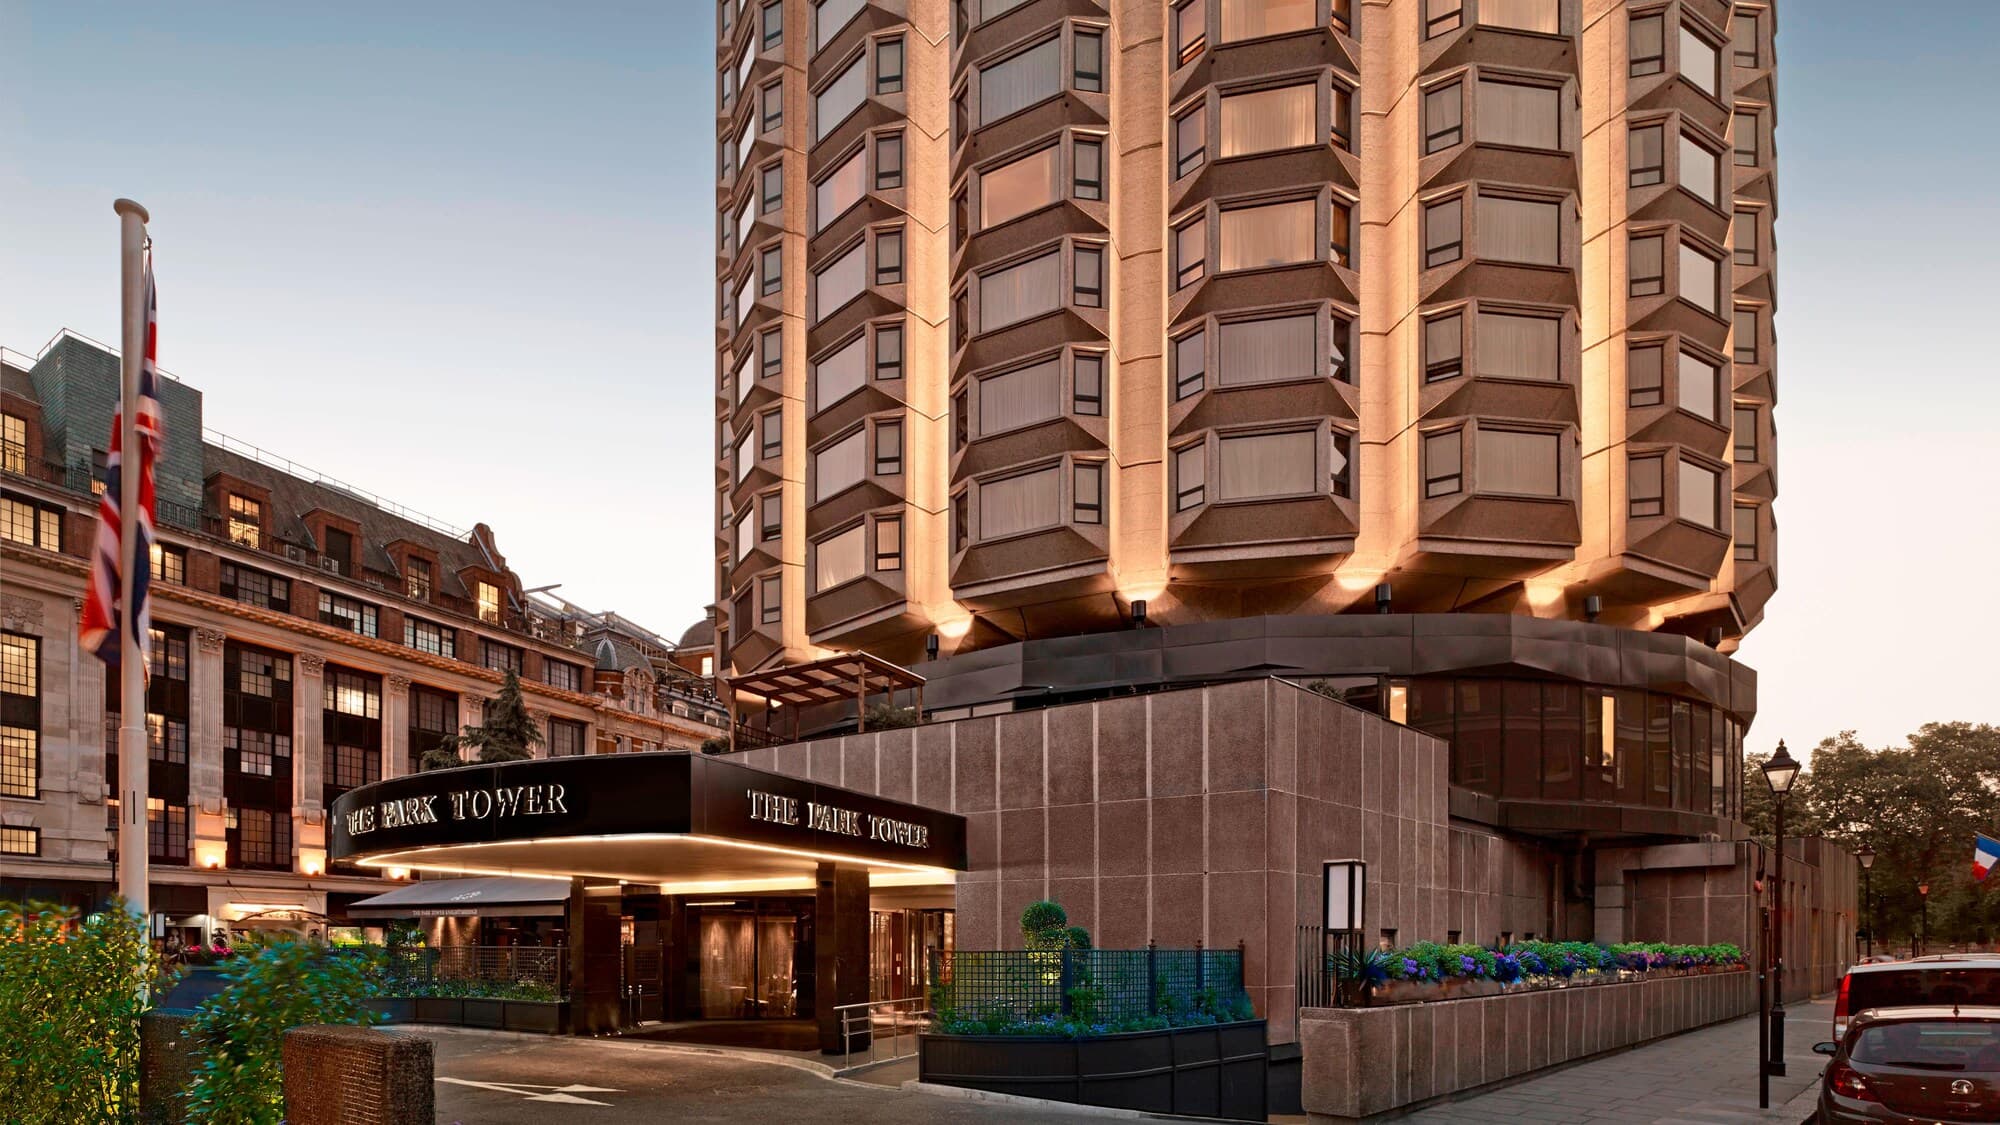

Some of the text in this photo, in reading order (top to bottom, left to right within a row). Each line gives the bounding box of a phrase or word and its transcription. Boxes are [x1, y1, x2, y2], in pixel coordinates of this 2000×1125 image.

[346, 783, 568, 836] THE PARK TOWER
[747, 788, 930, 849] THE PARK TOWER
